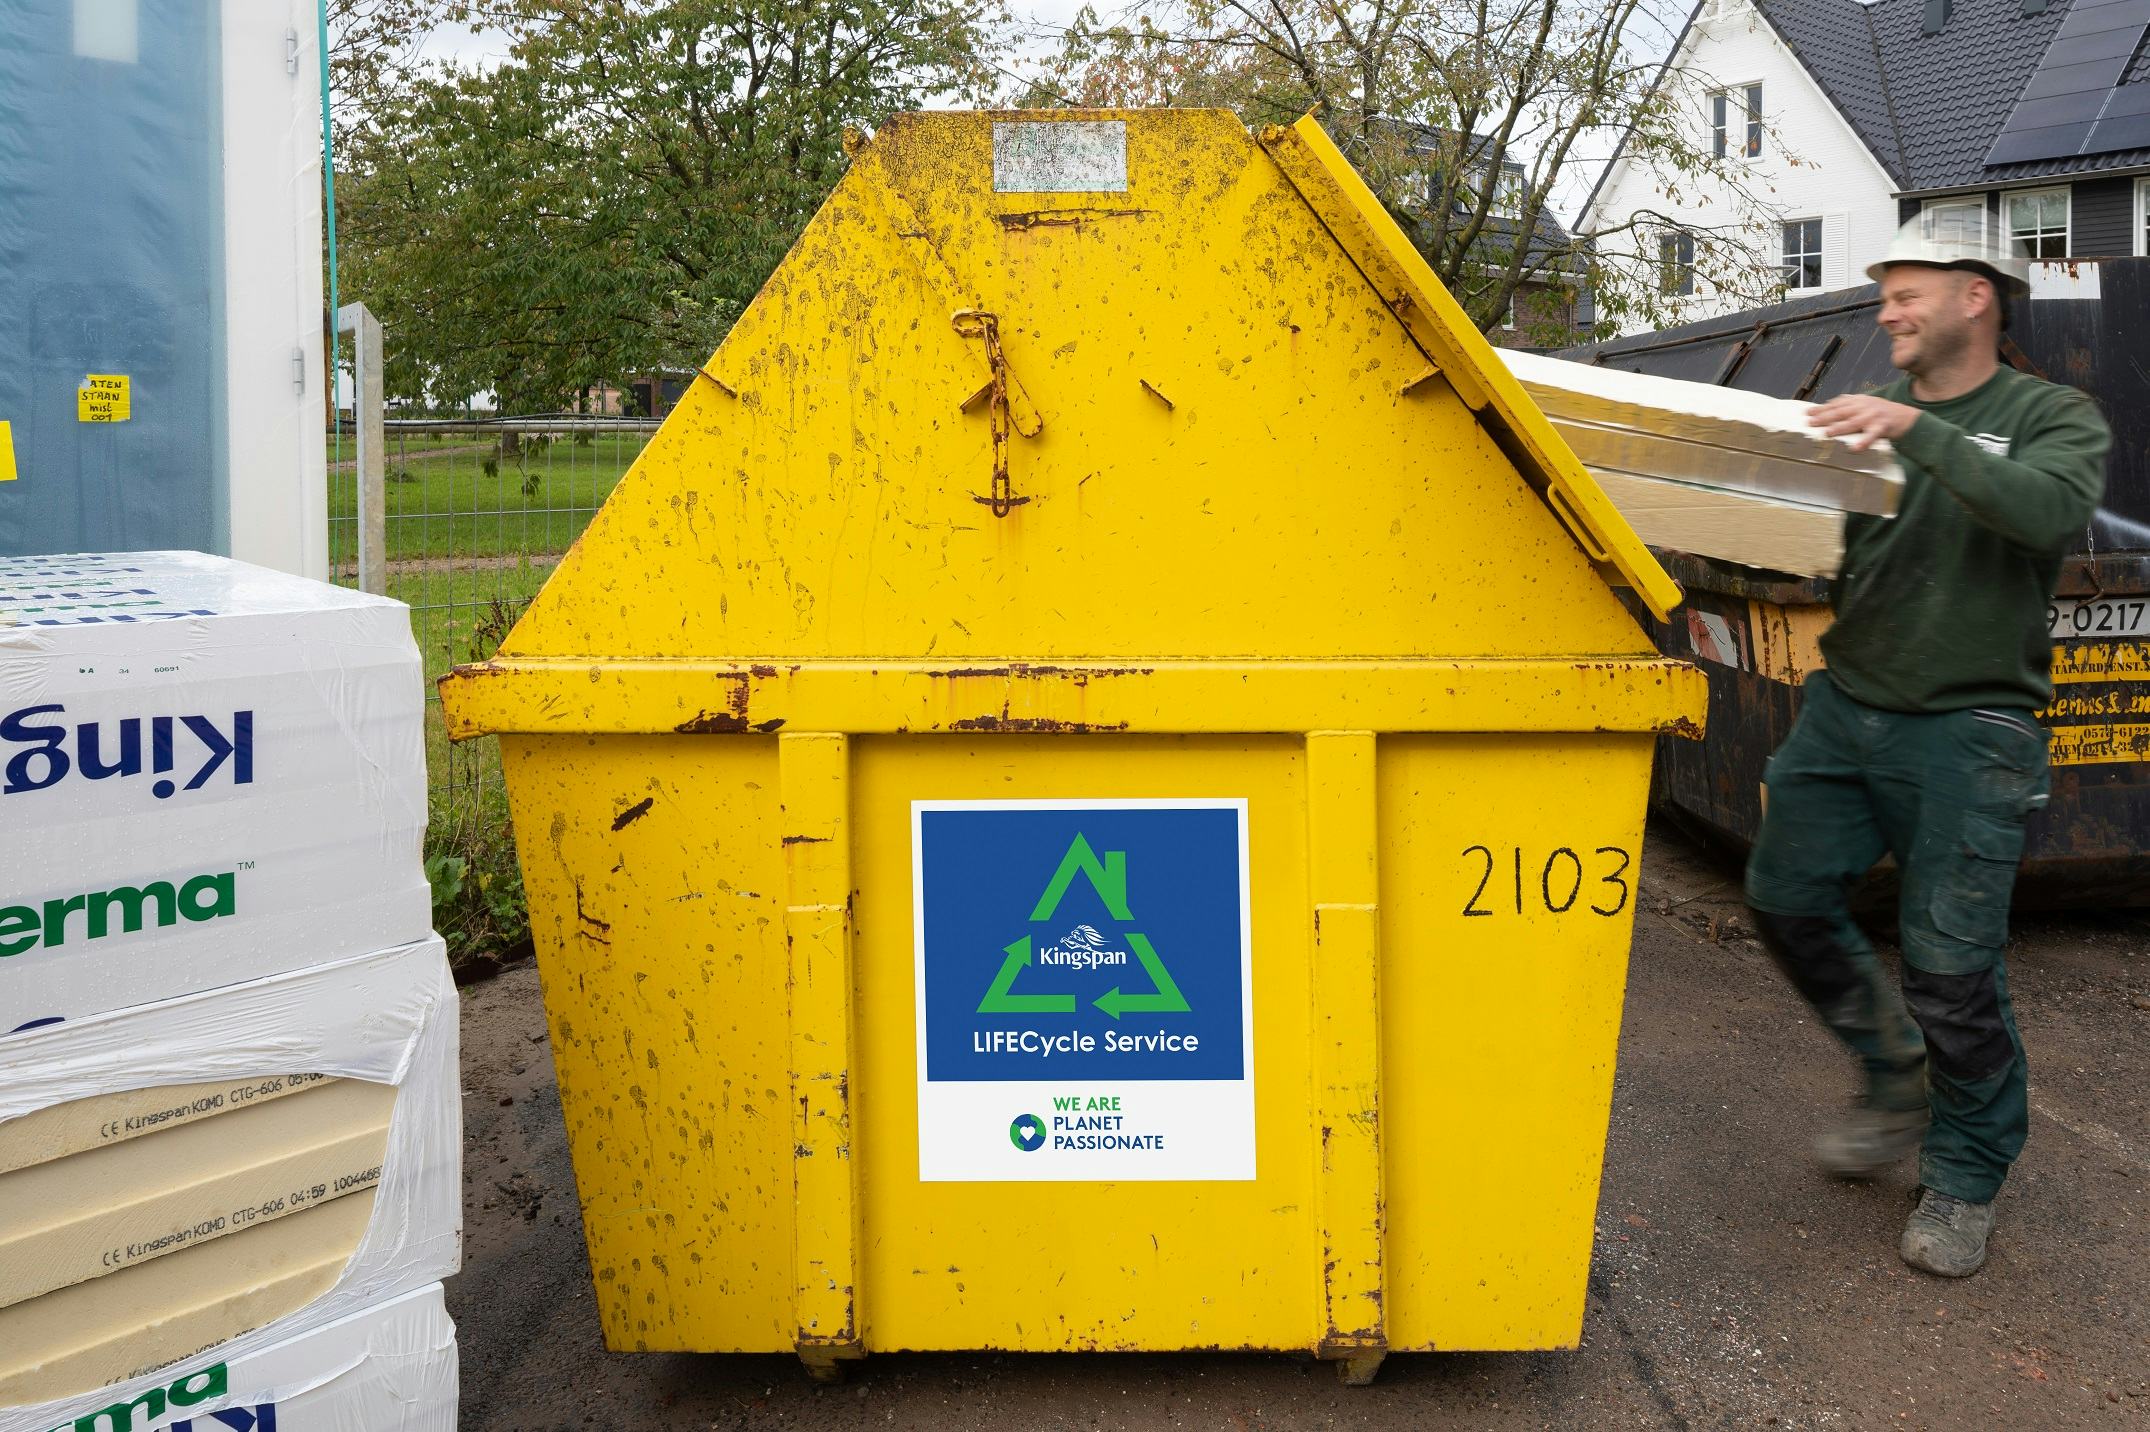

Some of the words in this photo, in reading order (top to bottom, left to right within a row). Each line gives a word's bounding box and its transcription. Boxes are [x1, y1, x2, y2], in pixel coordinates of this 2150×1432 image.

[82, 391, 120, 402] STAAN
[1461, 845, 1631, 917] 2103
[1040, 946, 1127, 970] Kingspan
[973, 1030, 1097, 1058] LIFECycle
[1104, 1029, 1200, 1053] Service
[125, 1105, 191, 1132] Kingspan
[230, 1078, 283, 1103] CTG-606
[1053, 1096, 1082, 1111] WE
[1086, 1096, 1122, 1111] ARE
[1053, 1116, 1124, 1131] PLANET
[1053, 1135, 1165, 1150] PASSIONATE
[126, 1229, 192, 1259] Kingspan
[232, 1198, 285, 1225] CTG-606
[290, 1183, 327, 1205] 04:59
